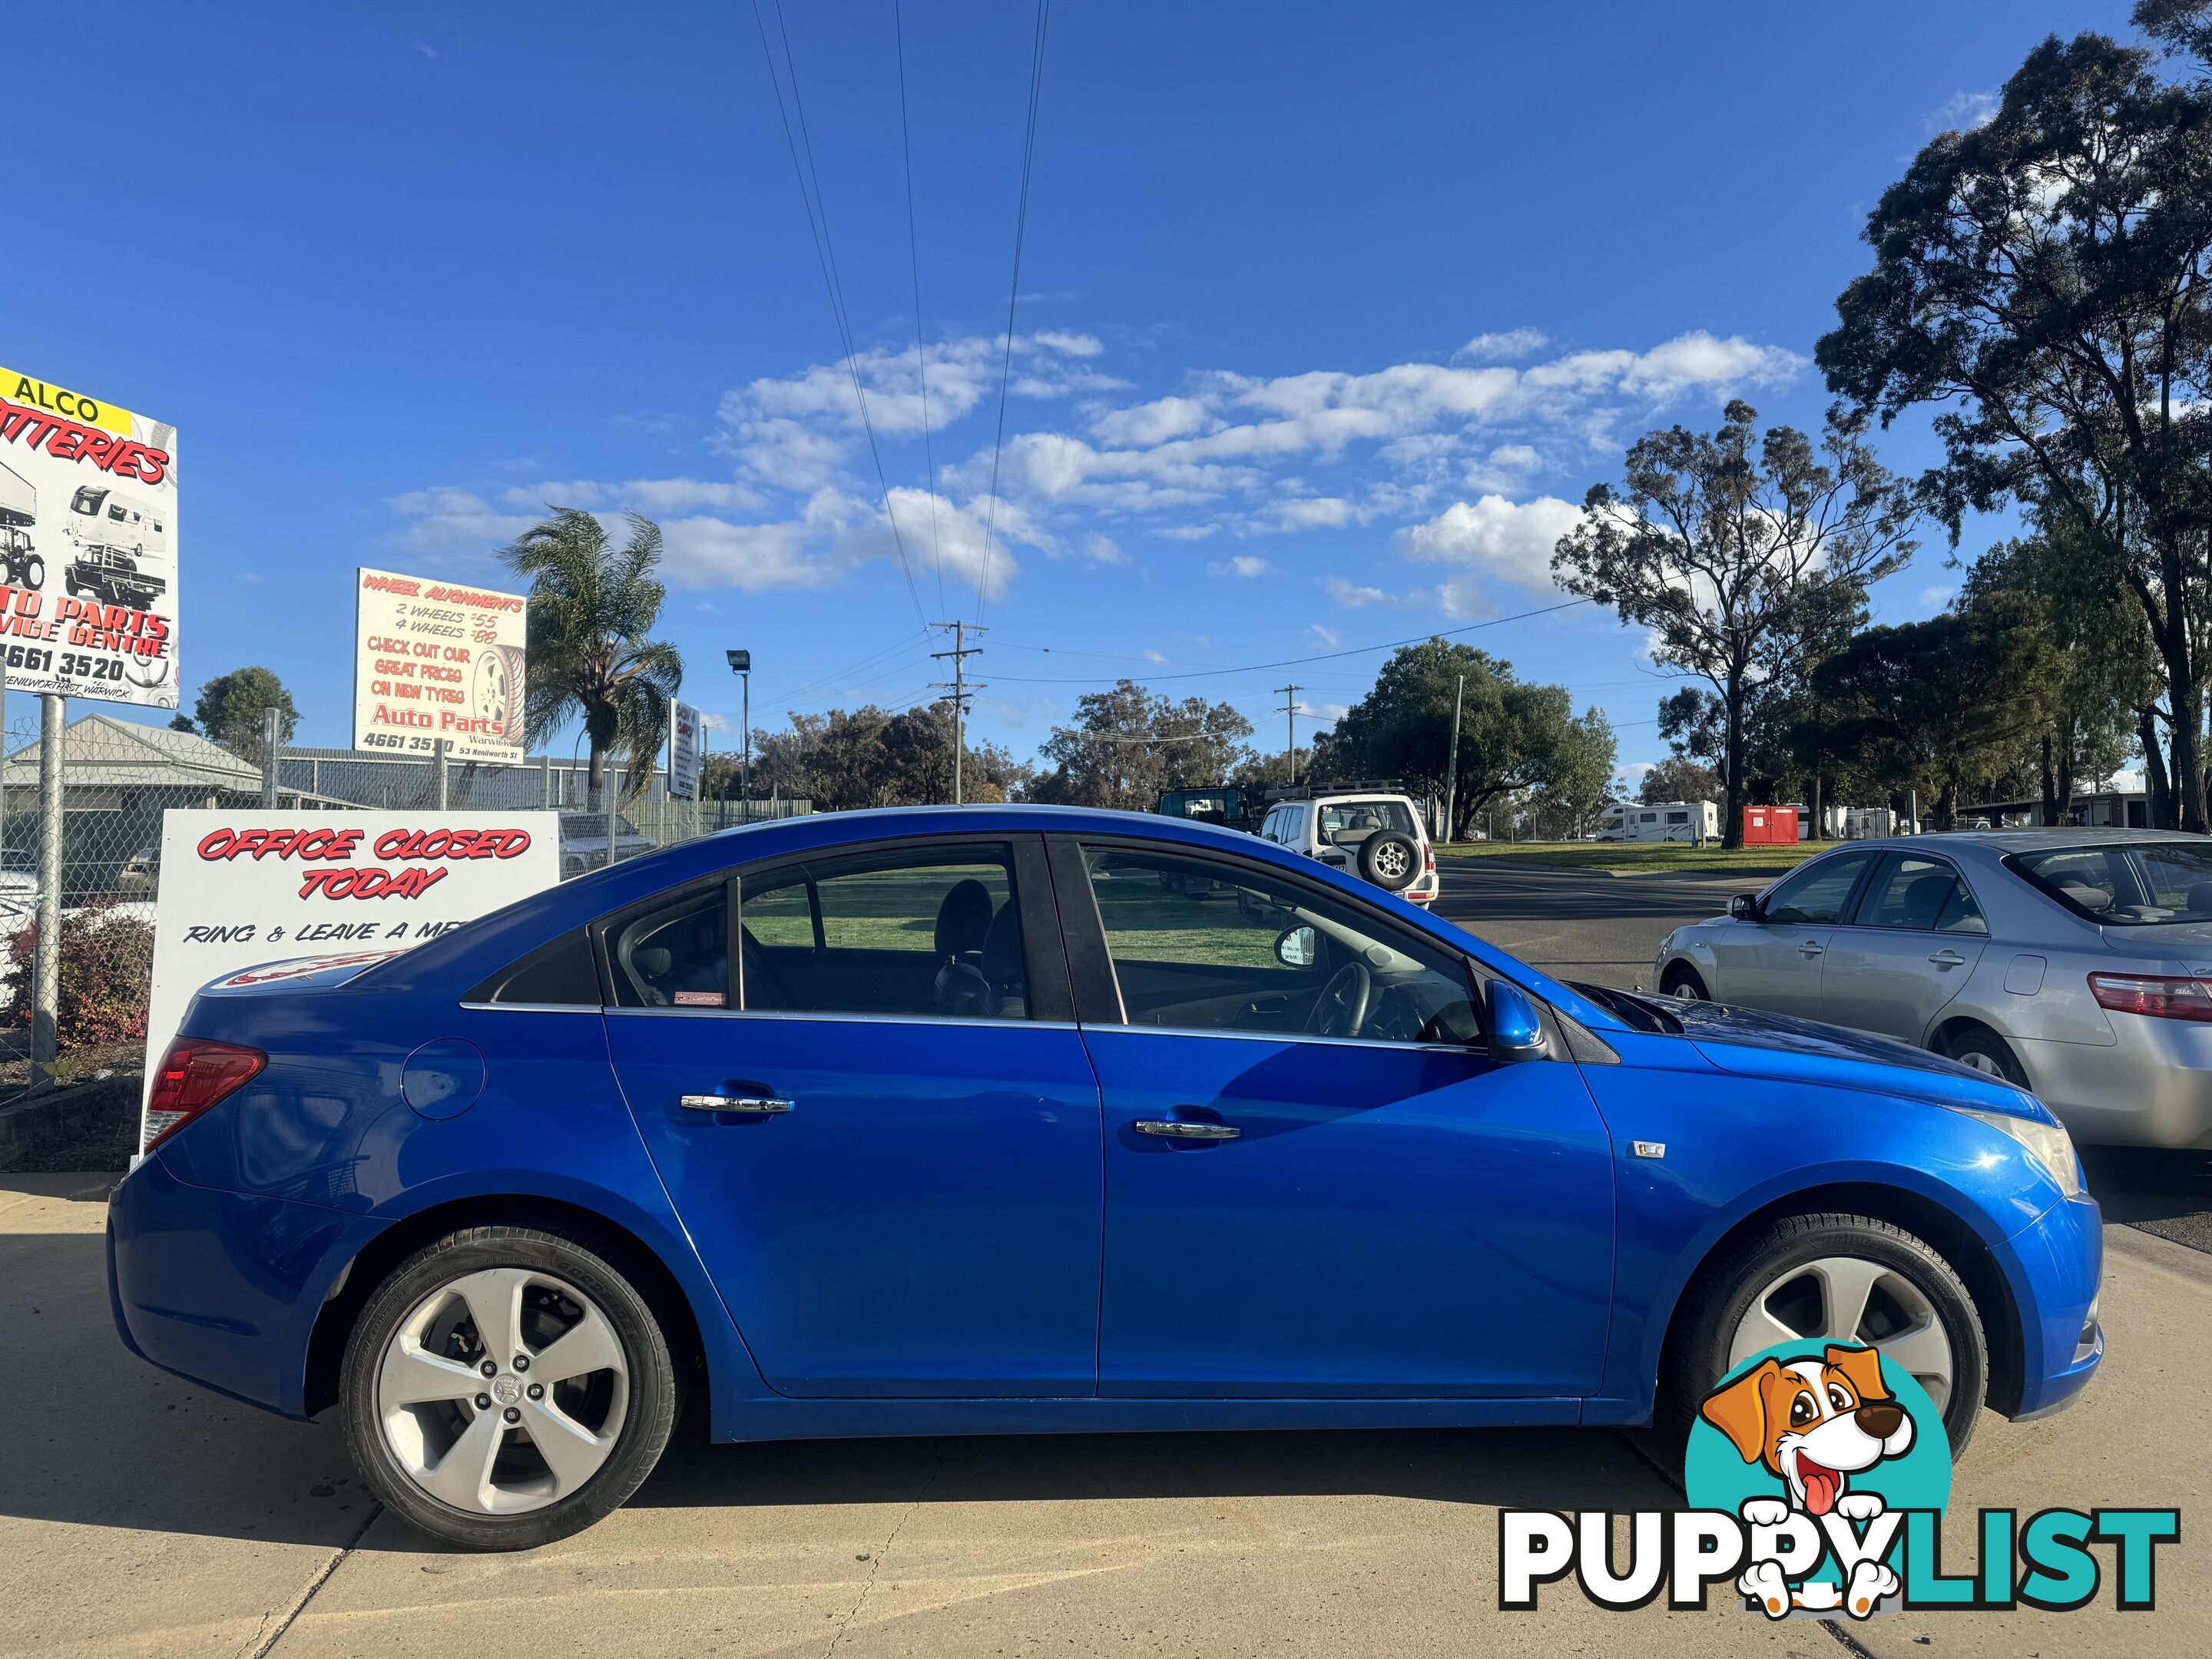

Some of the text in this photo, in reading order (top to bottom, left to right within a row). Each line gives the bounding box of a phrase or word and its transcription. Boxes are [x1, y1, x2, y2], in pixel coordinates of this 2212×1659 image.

[14, 377, 98, 422] ALCO
[363, 575, 523, 612] WHEEL ALIGNMENTS
[55, 596, 171, 641] PARTS
[396, 603, 407, 614] 2
[410, 605, 465, 623] WHEELS
[68, 625, 170, 659] CENTRE
[396, 619, 406, 630] 4
[410, 621, 465, 638] WHEELS
[367, 635, 471, 664] CHECK OUT OUR
[59, 652, 124, 681] 3520
[375, 658, 462, 683] GREAT PRICES
[84, 685, 130, 698] WARWICK
[371, 680, 465, 704] ON NEW TYRES
[371, 704, 505, 735] Auto Parts
[363, 733, 454, 753] 4661 350
[469, 735, 510, 747] Warwick
[472, 749, 508, 757] Kenilworth
[197, 828, 531, 862] OFFICE CLOSED
[298, 866, 448, 901] TODAY
[183, 921, 467, 943] RING & LEAVE A ME
